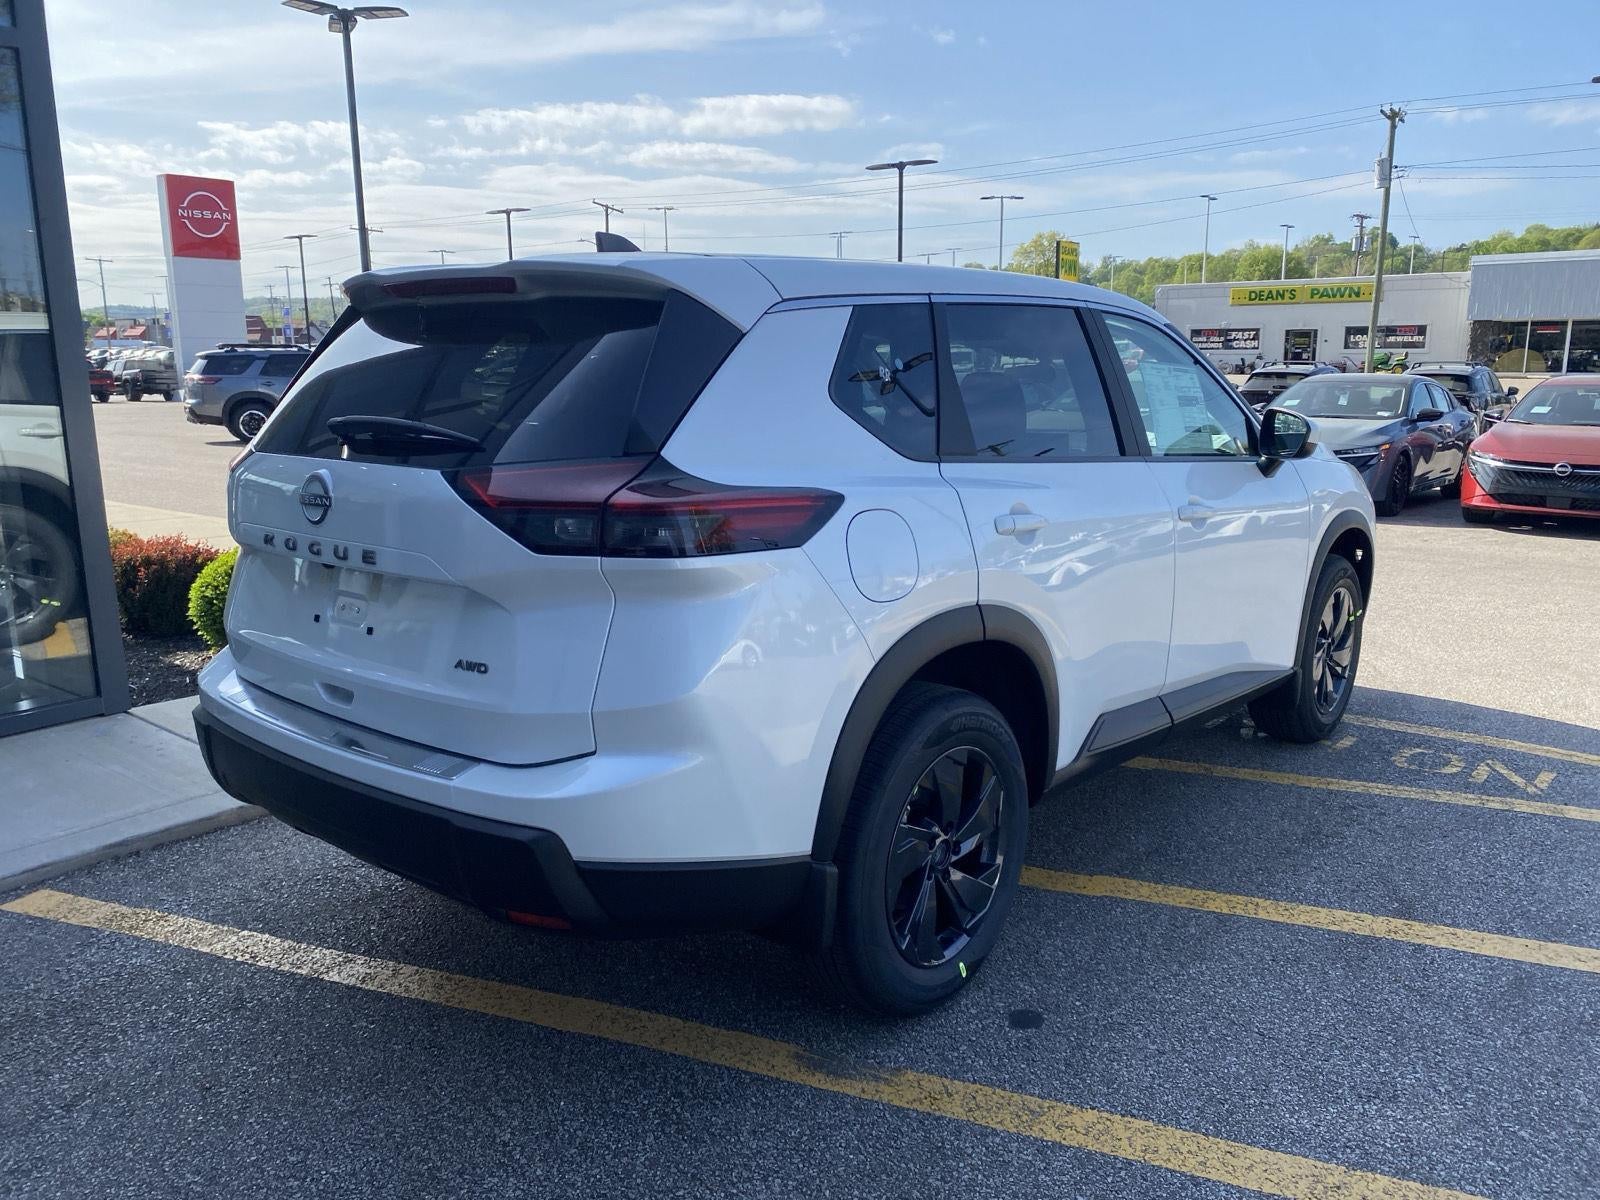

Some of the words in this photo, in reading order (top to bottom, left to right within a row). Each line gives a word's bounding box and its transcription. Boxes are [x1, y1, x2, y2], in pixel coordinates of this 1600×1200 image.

[178, 208, 231, 220] NISSAN
[1248, 288, 1297, 302] DEAN'S
[1309, 286, 1361, 299] PAWN
[1230, 331, 1256, 340] FAST
[1350, 334, 1369, 342] LOA
[1233, 340, 1259, 348] CASH
[263, 534, 377, 565] ROGUE
[454, 659, 489, 674] AWD
